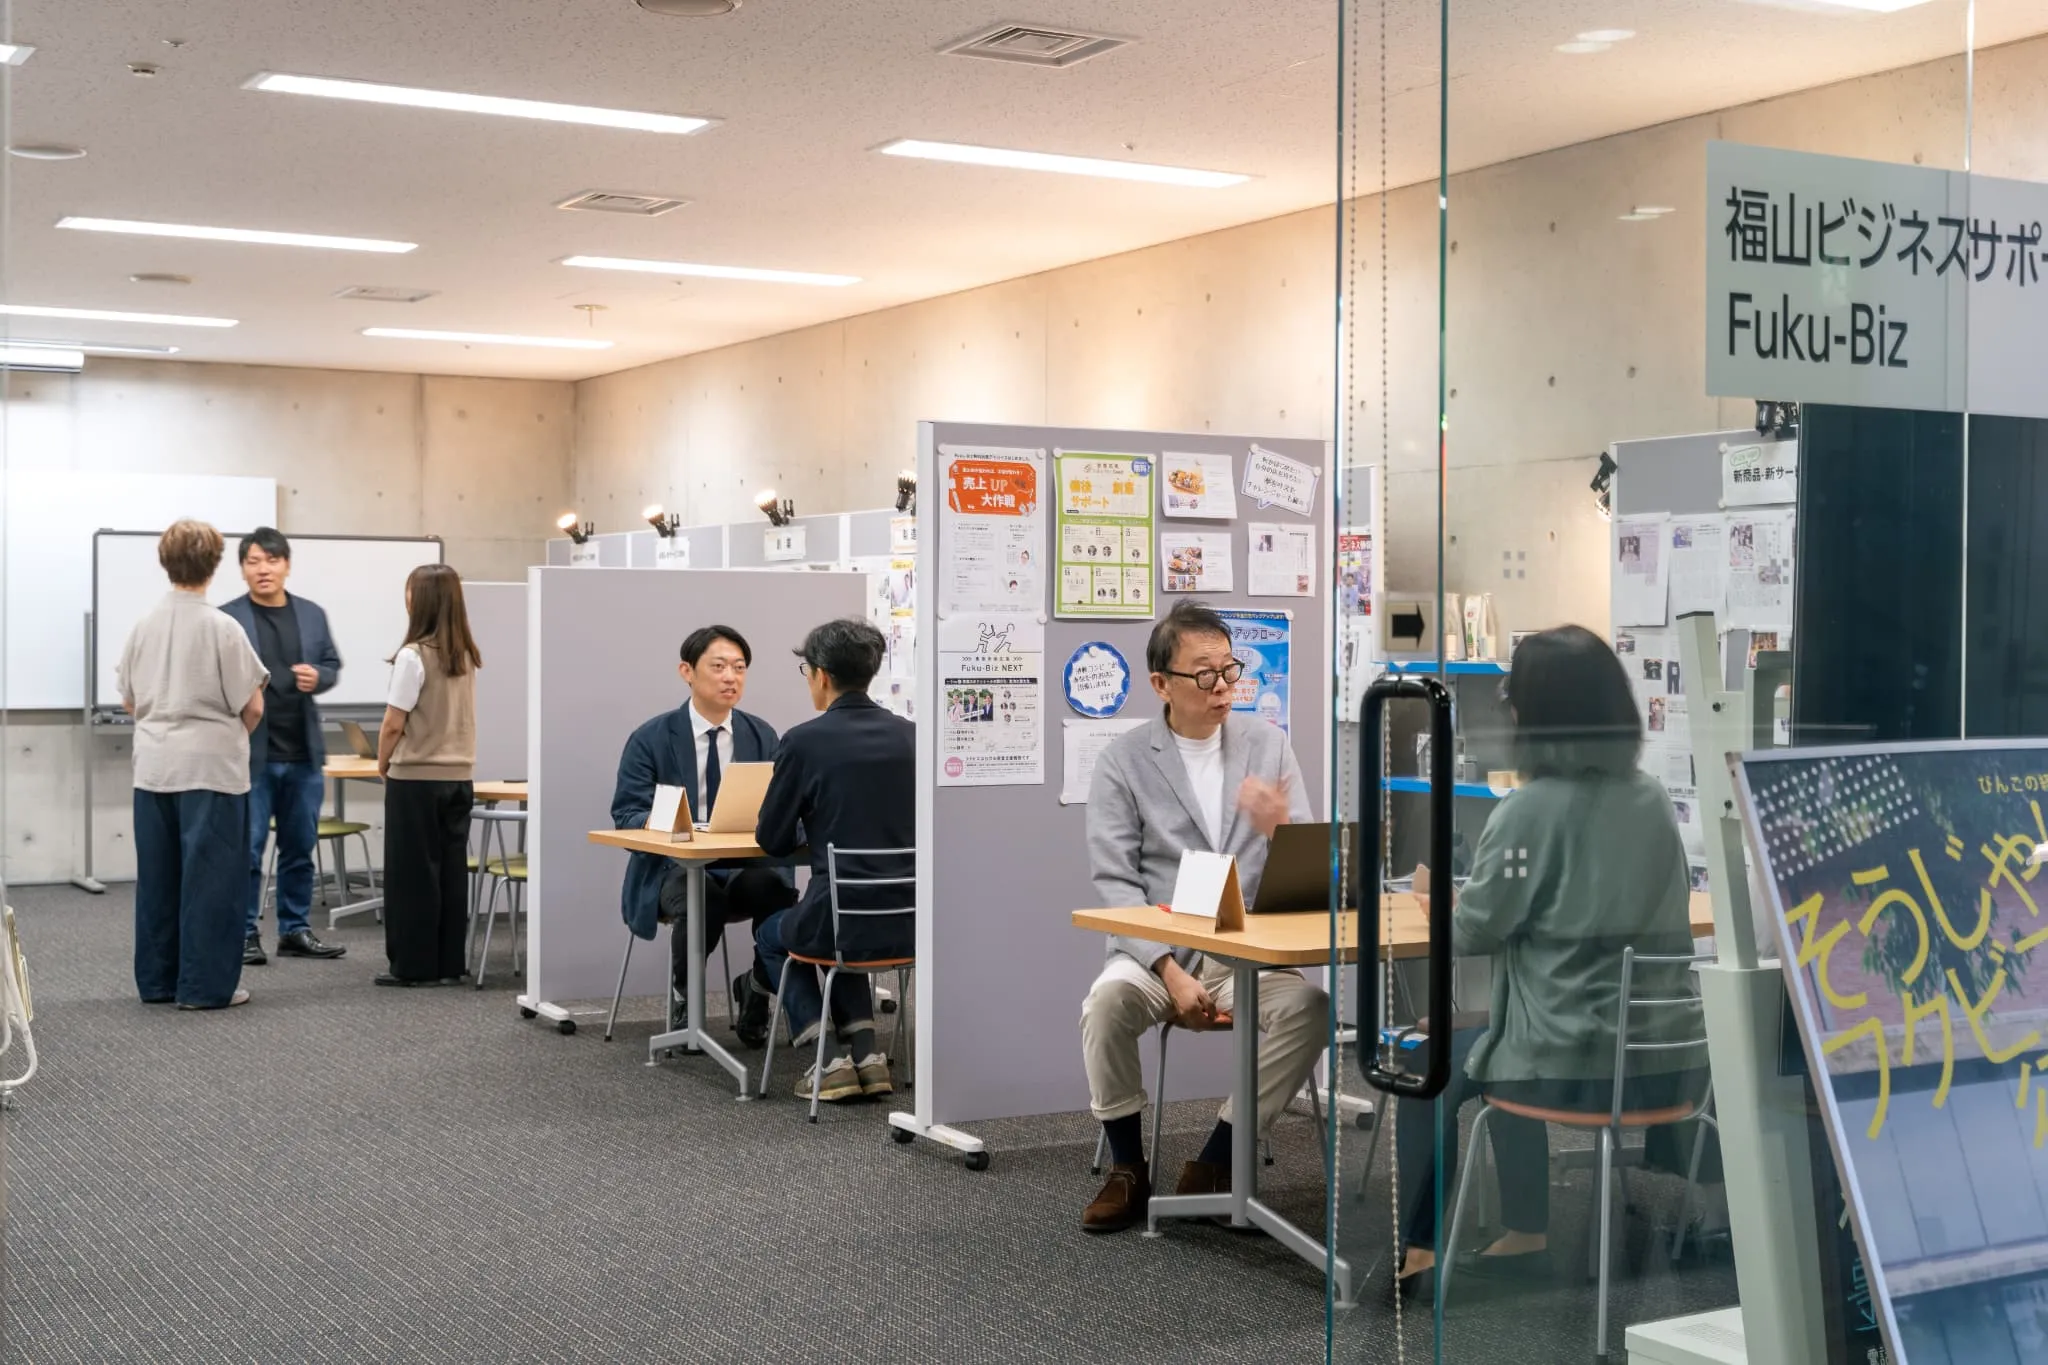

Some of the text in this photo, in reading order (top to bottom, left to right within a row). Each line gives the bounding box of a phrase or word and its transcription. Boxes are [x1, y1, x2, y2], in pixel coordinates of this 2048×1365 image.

[1725, 185, 2048, 288] 福山ビジネスサポ
[1729, 291, 1908, 369] Fuku-Biz
[981, 493, 1016, 508] 大作戦
[961, 664, 1023, 672] Fuku-Biz NEXT
